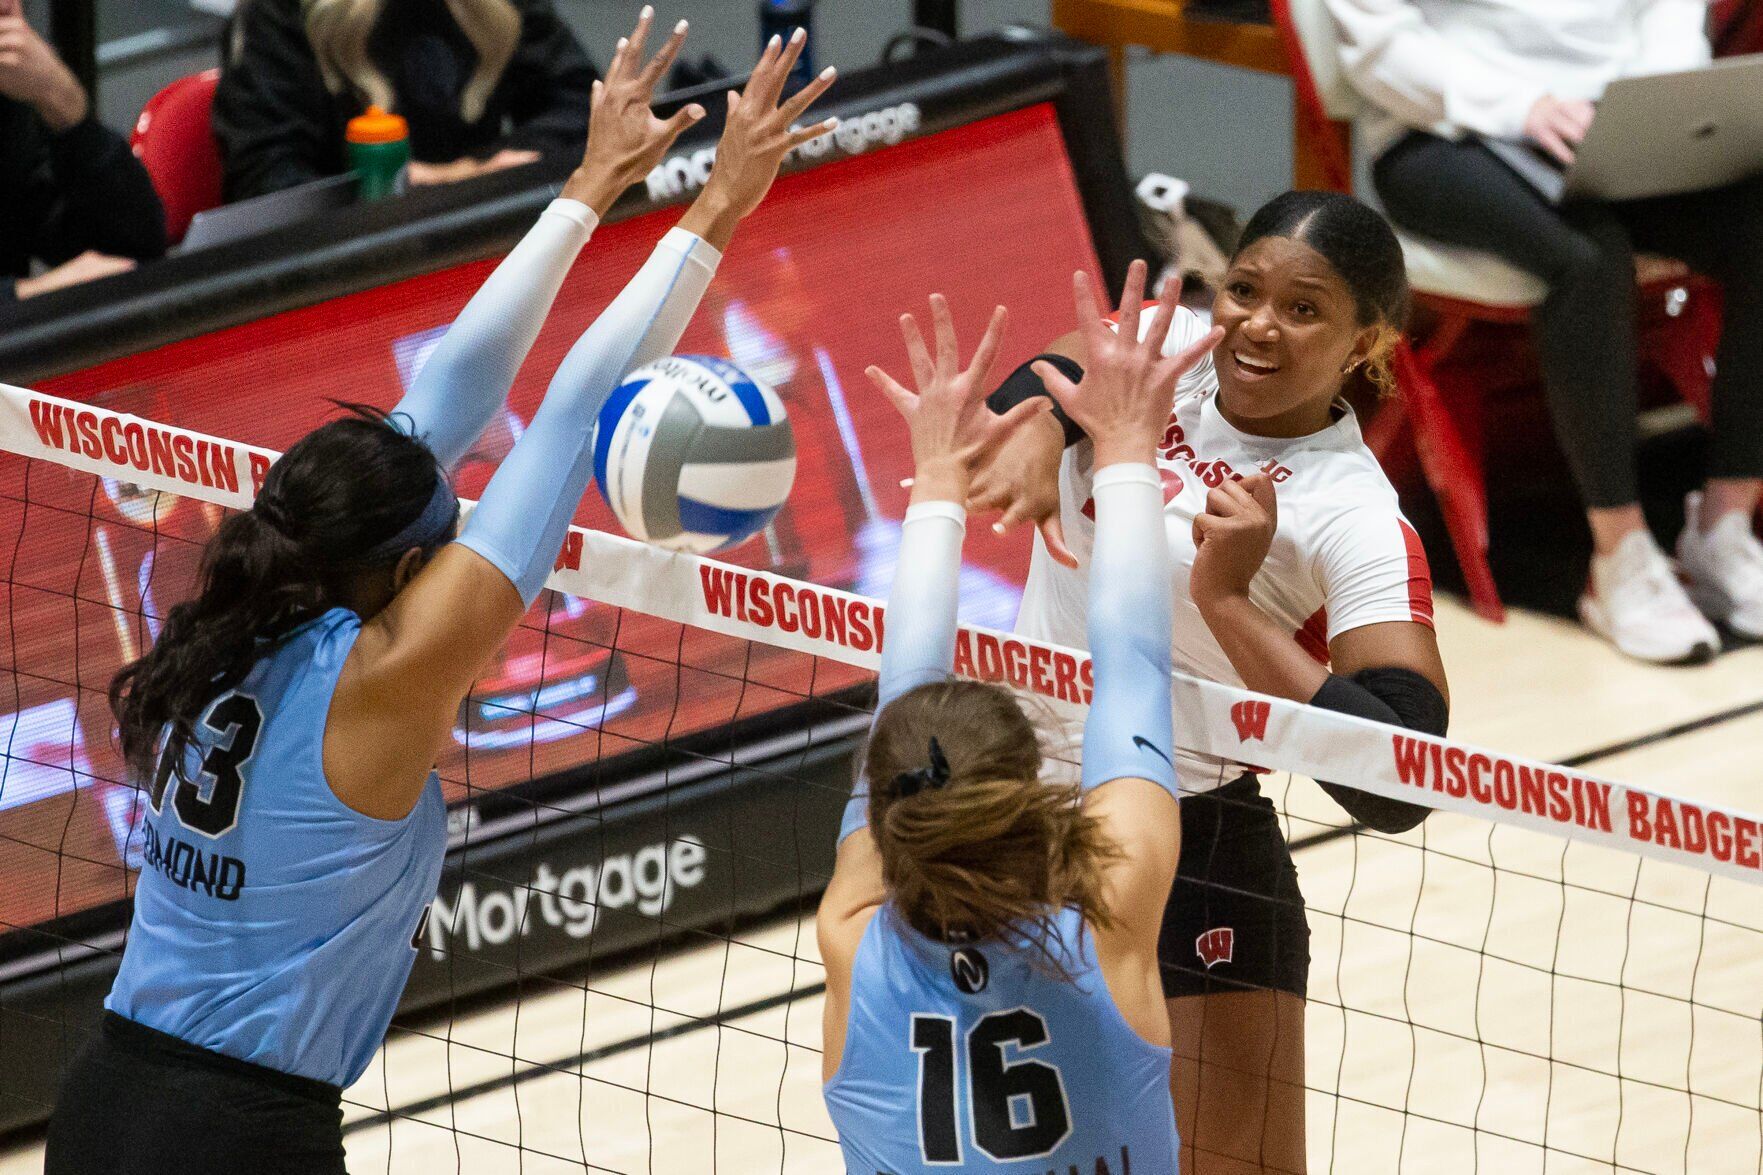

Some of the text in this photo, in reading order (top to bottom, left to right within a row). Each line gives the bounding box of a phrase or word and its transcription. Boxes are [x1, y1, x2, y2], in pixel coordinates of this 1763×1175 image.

[29, 399, 239, 494] WISCONSIN
[699, 565, 1094, 707] WISCONSI ADGERS
[150, 689, 265, 840] 13
[1231, 700, 1272, 743] W
[1393, 733, 1763, 871] WISCONSIN BADGE
[428, 834, 706, 961] Mortgage
[909, 1006, 1073, 1166] 16
